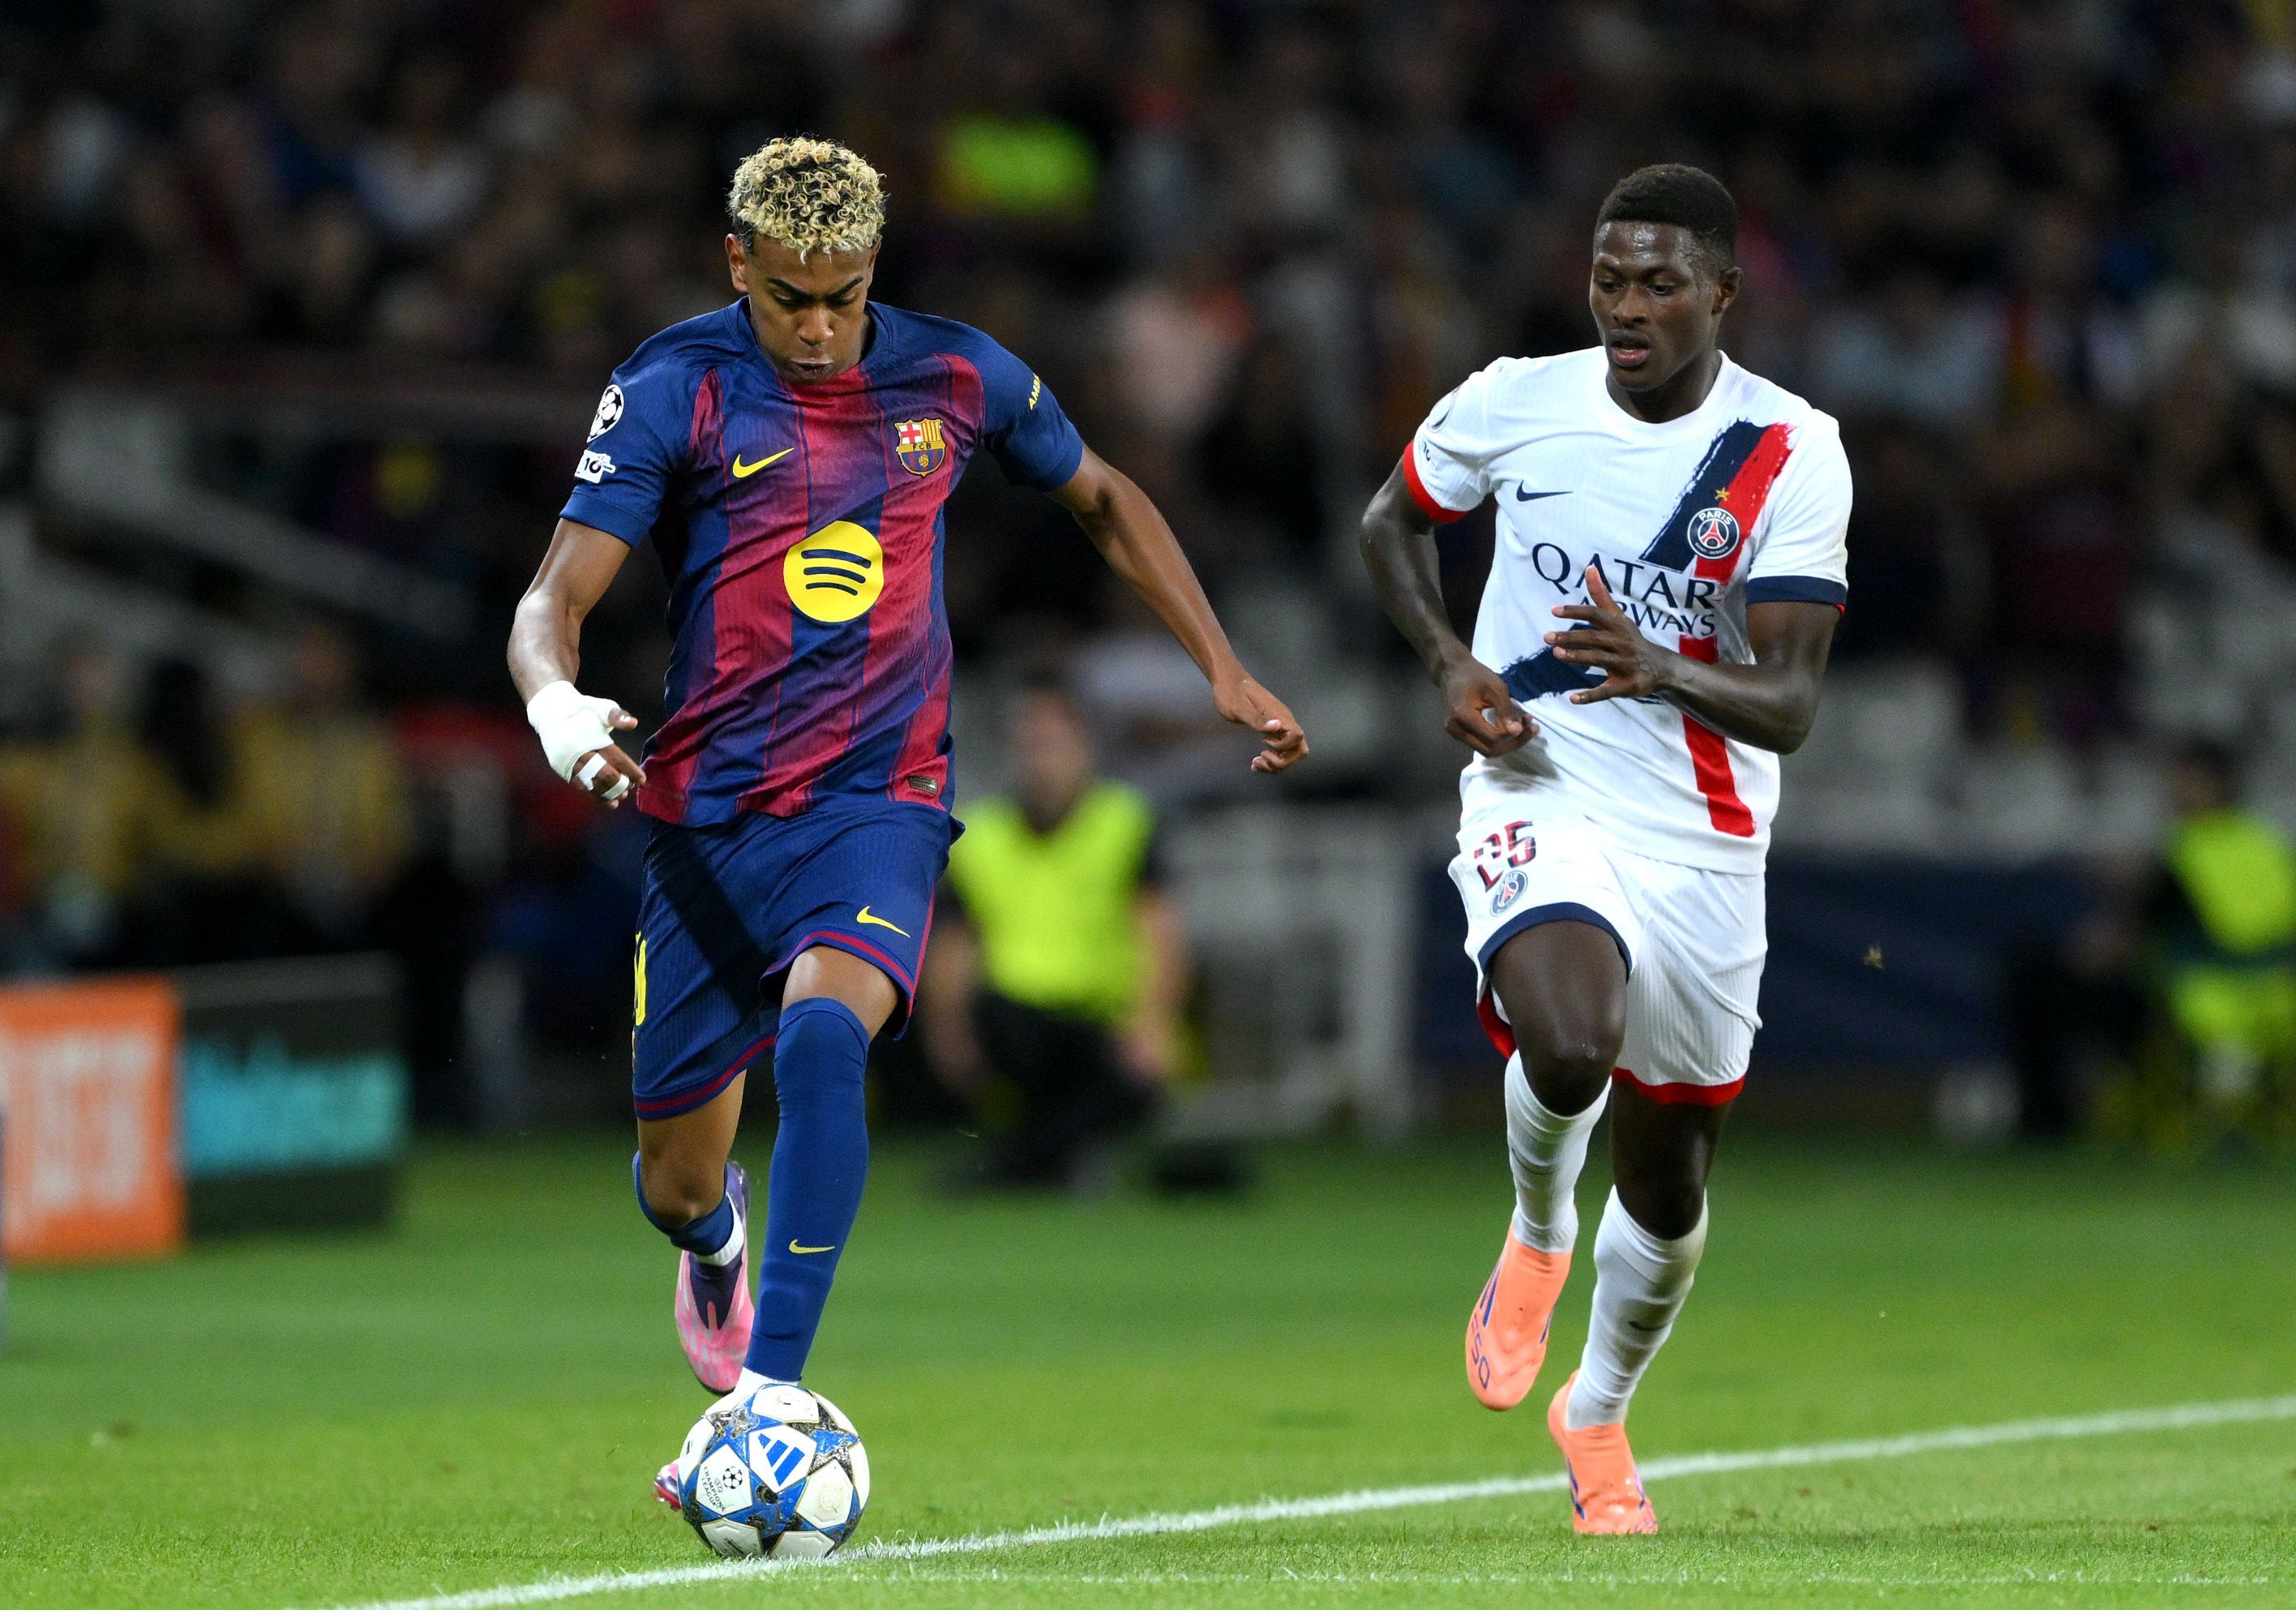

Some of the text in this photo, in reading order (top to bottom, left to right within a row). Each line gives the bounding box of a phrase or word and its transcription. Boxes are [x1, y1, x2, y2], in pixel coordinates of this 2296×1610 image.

[1698, 511, 1733, 525] PARIS
[1531, 542, 1716, 610] QATAR
[1580, 597, 1716, 636] WAYS
[1474, 820, 1536, 893] 25
[704, 1467, 726, 1512] CHAMPIONS
